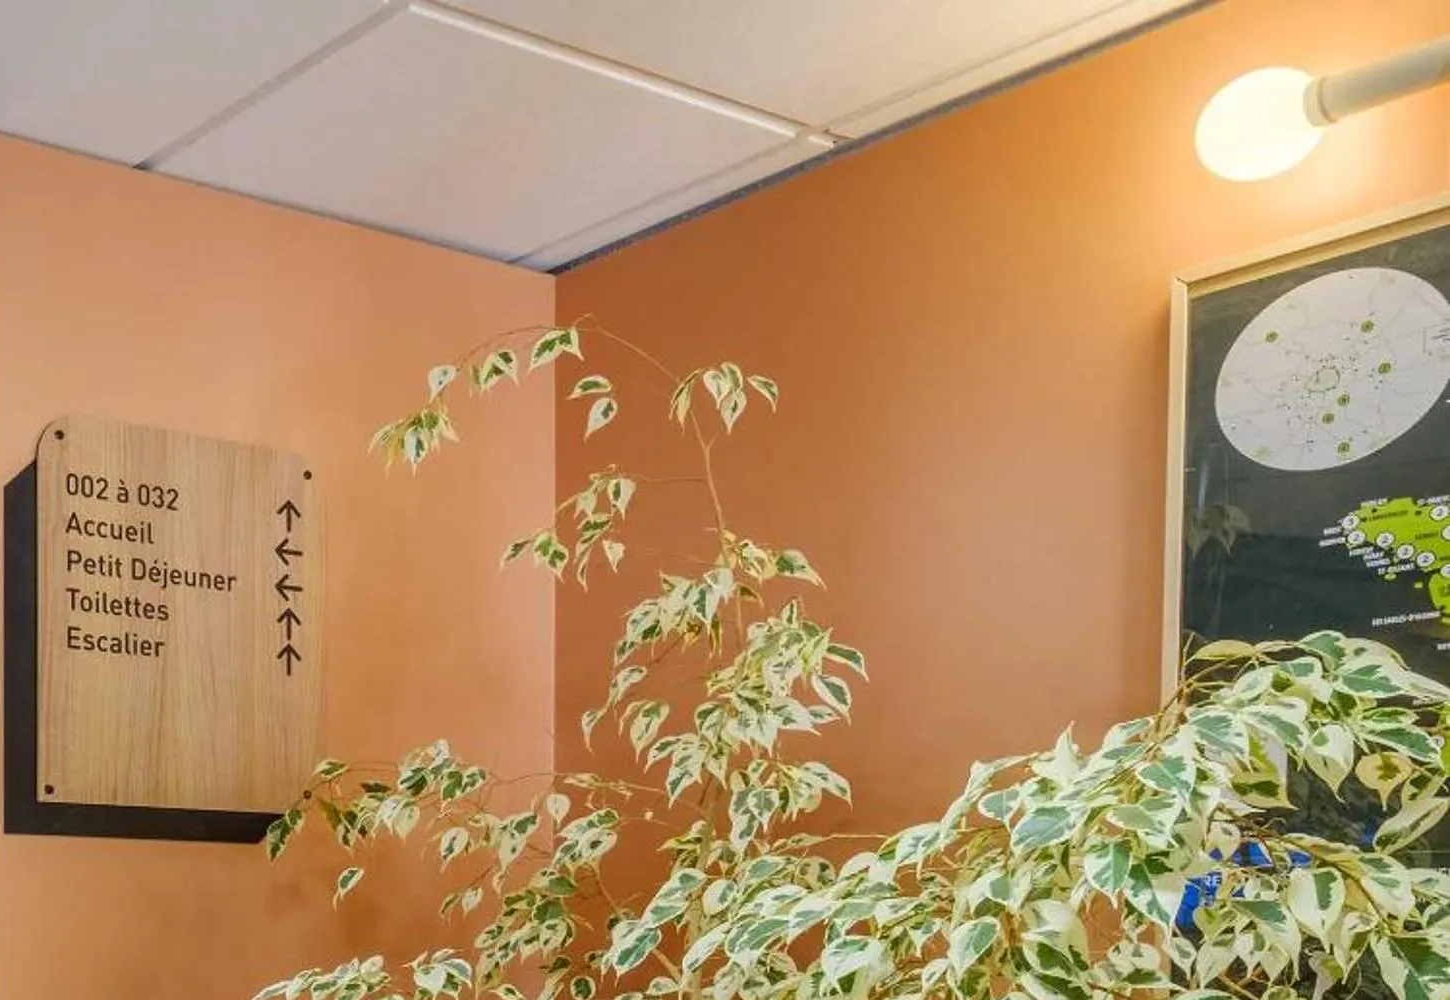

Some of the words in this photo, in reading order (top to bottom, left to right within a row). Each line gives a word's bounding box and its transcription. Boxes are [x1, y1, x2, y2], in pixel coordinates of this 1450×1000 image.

[65, 472, 108, 502] 002
[116, 478, 130, 504] à
[137, 484, 180, 512] 032
[65, 511, 155, 546] Accueil
[66, 549, 124, 581] Petit
[130, 557, 237, 593] Déjeuner
[65, 587, 171, 622] Toilettes
[66, 625, 165, 658] Escalier
